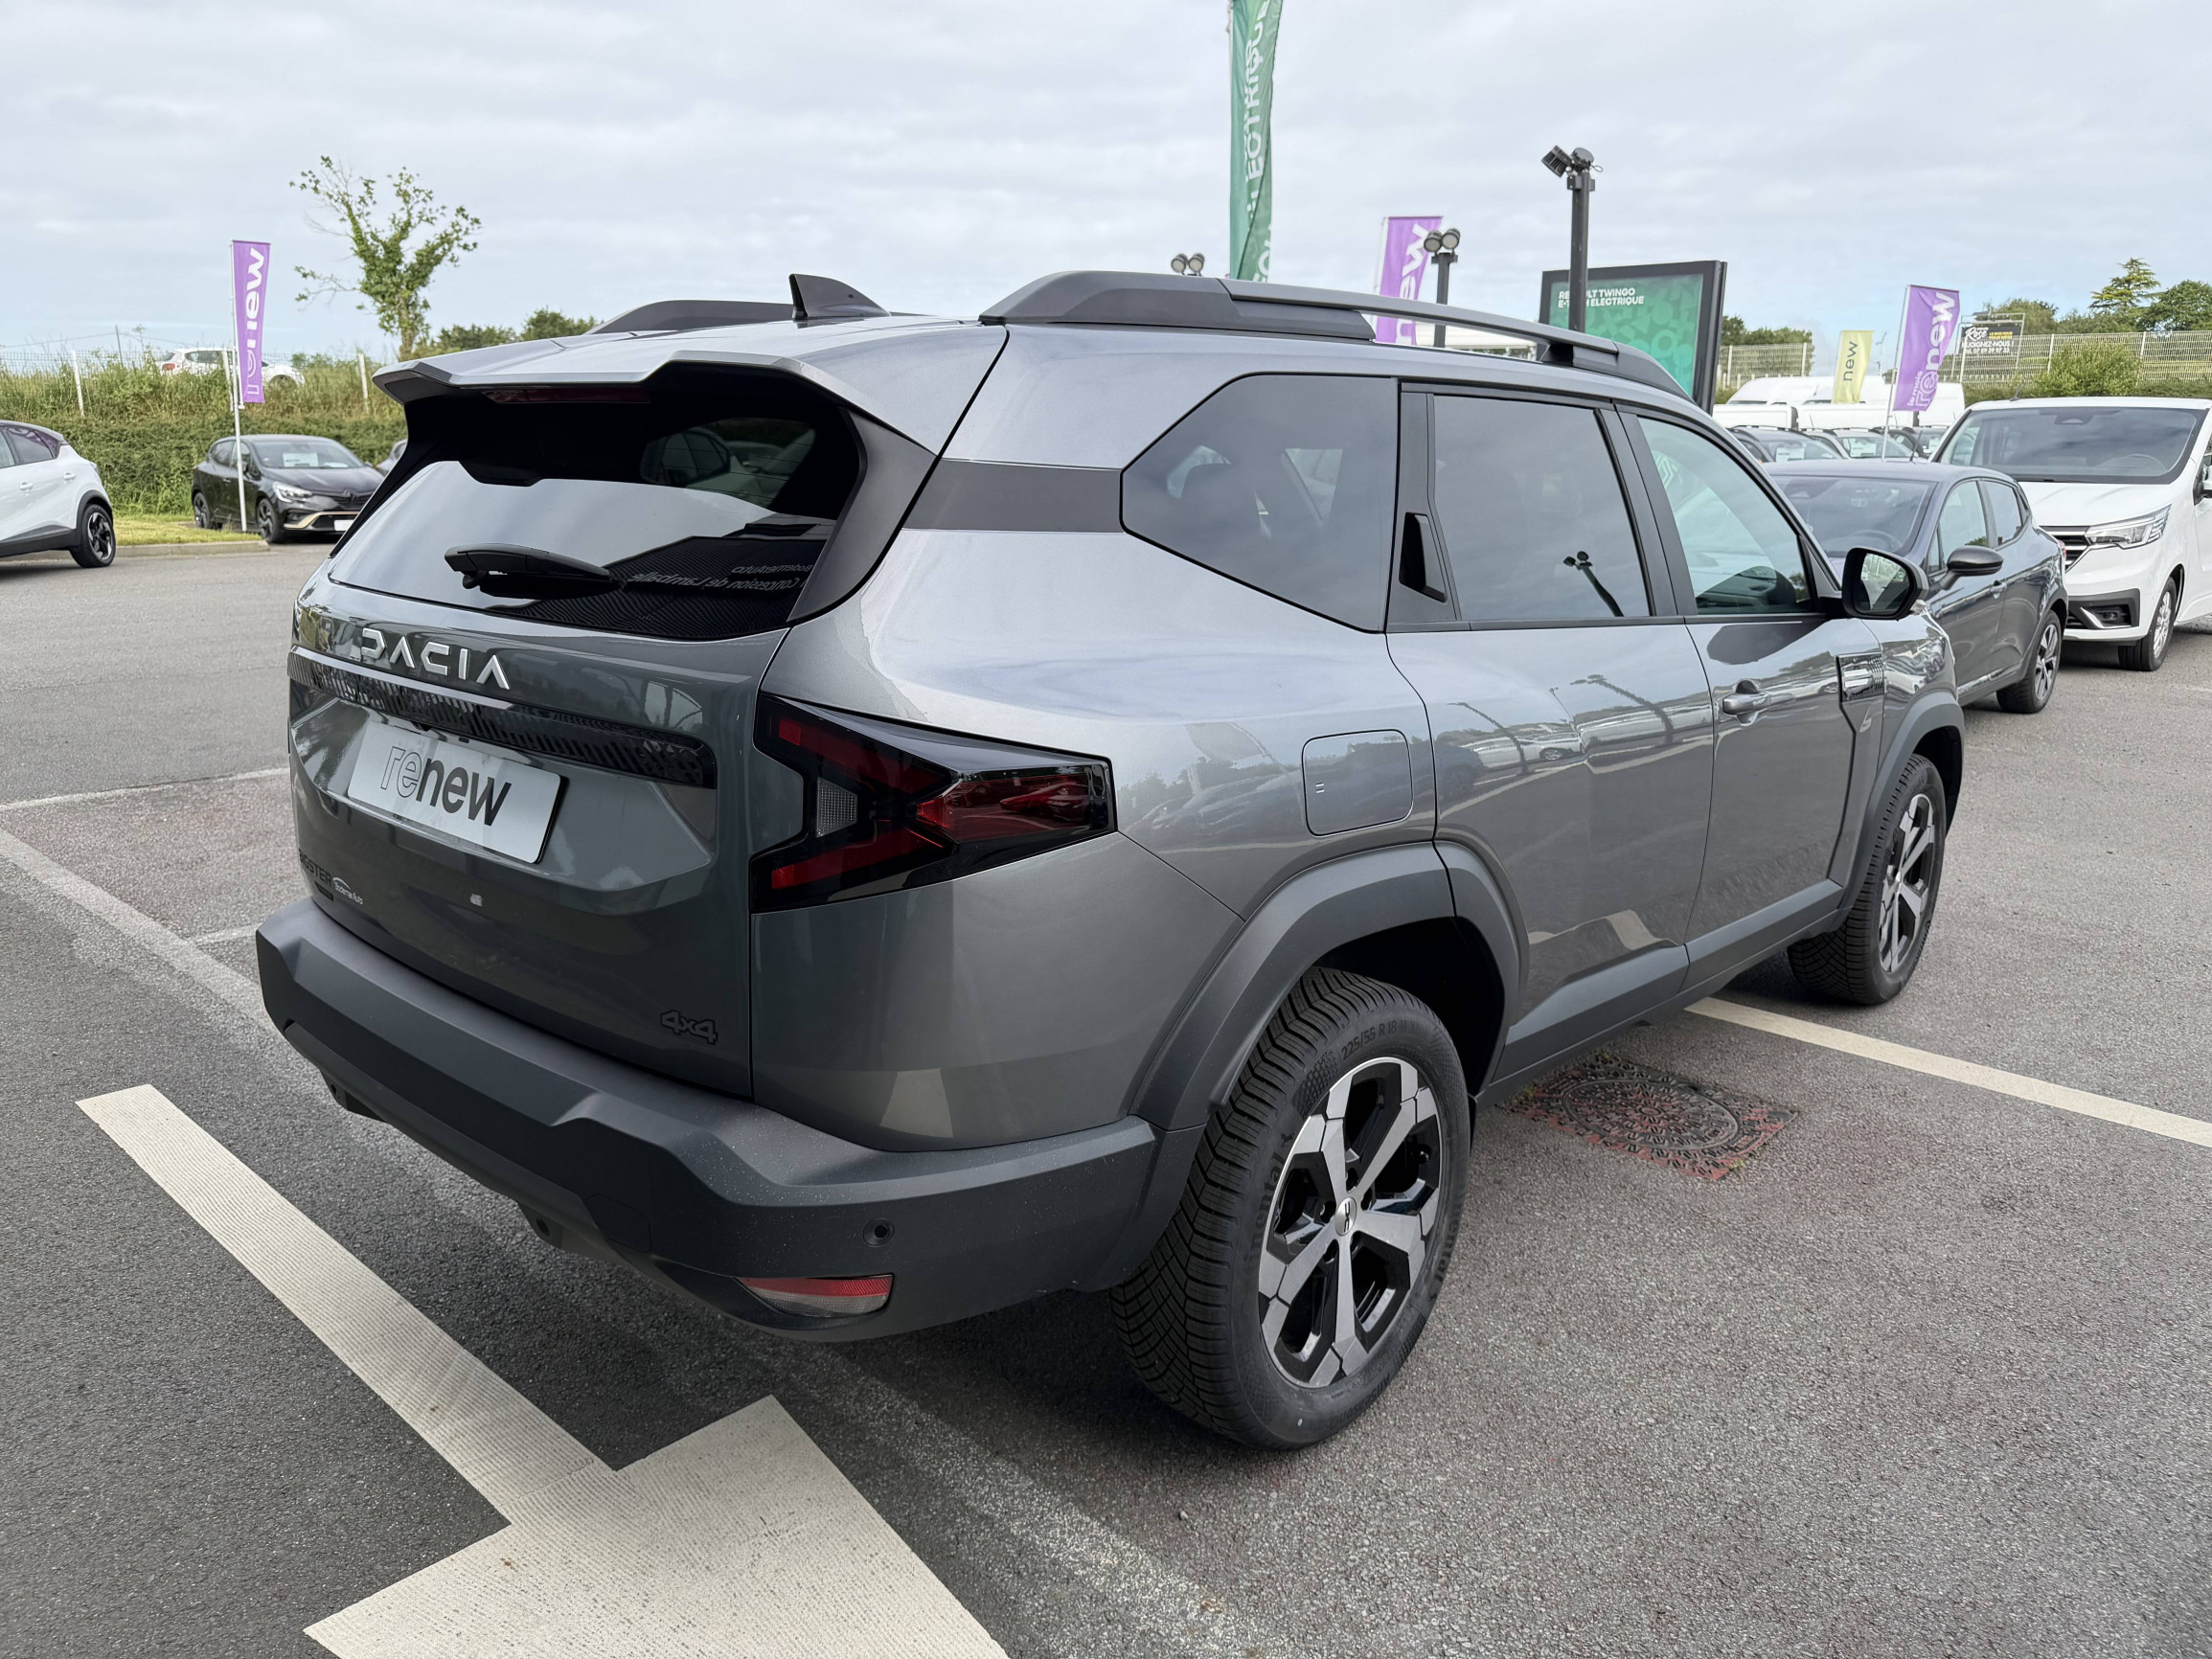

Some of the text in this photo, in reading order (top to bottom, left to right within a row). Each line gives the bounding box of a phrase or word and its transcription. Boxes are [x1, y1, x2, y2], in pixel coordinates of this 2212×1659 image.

[1558, 296, 1645, 308] E-T ELECTRIQUE
[1559, 287, 1635, 300] RELT TWINGO
[1843, 341, 1858, 381] new
[1915, 291, 1955, 407] renew
[361, 627, 511, 691] DACIA
[380, 745, 513, 827] renew
[660, 1010, 718, 1046] 4x4
[1341, 1026, 1377, 1061] 225/55
